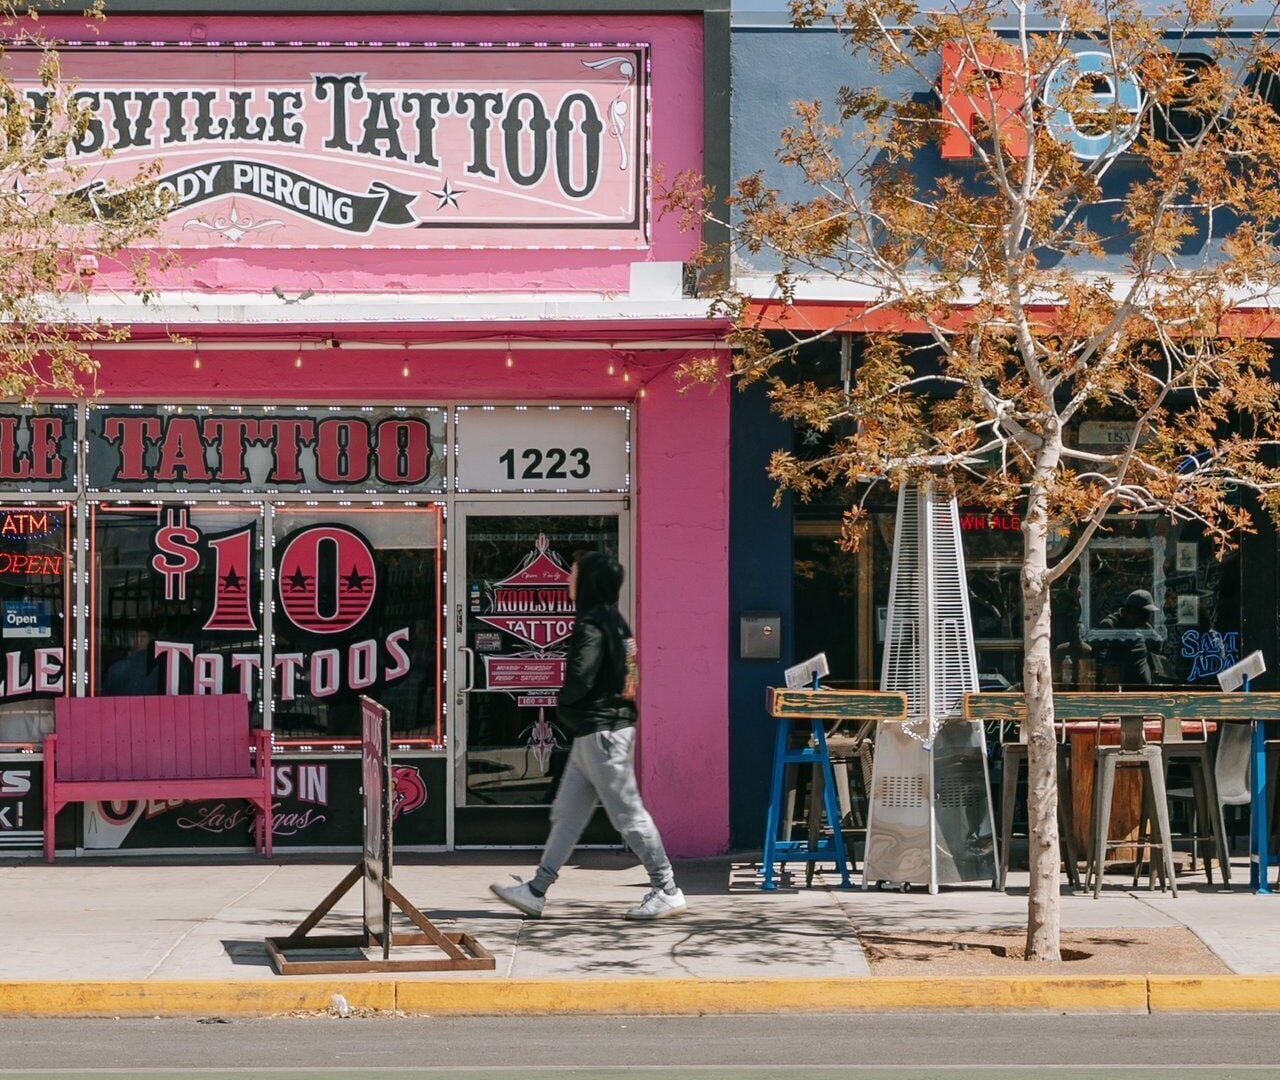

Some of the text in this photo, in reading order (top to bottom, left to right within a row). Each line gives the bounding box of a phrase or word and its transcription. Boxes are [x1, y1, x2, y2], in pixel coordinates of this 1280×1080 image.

[316, 76, 606, 199] TATTOO
[148, 163, 355, 226] ODY PIERCING
[105, 415, 431, 483] TATTOO
[499, 448, 592, 481] 1223
[1, 514, 48, 534] ATM
[152, 508, 377, 634] $10
[6, 614, 38, 626] Open
[496, 589, 577, 612] KOOLSVIL
[154, 626, 411, 701] TATTOOS
[297, 764, 328, 806] IN
[177, 803, 247, 834] Las
